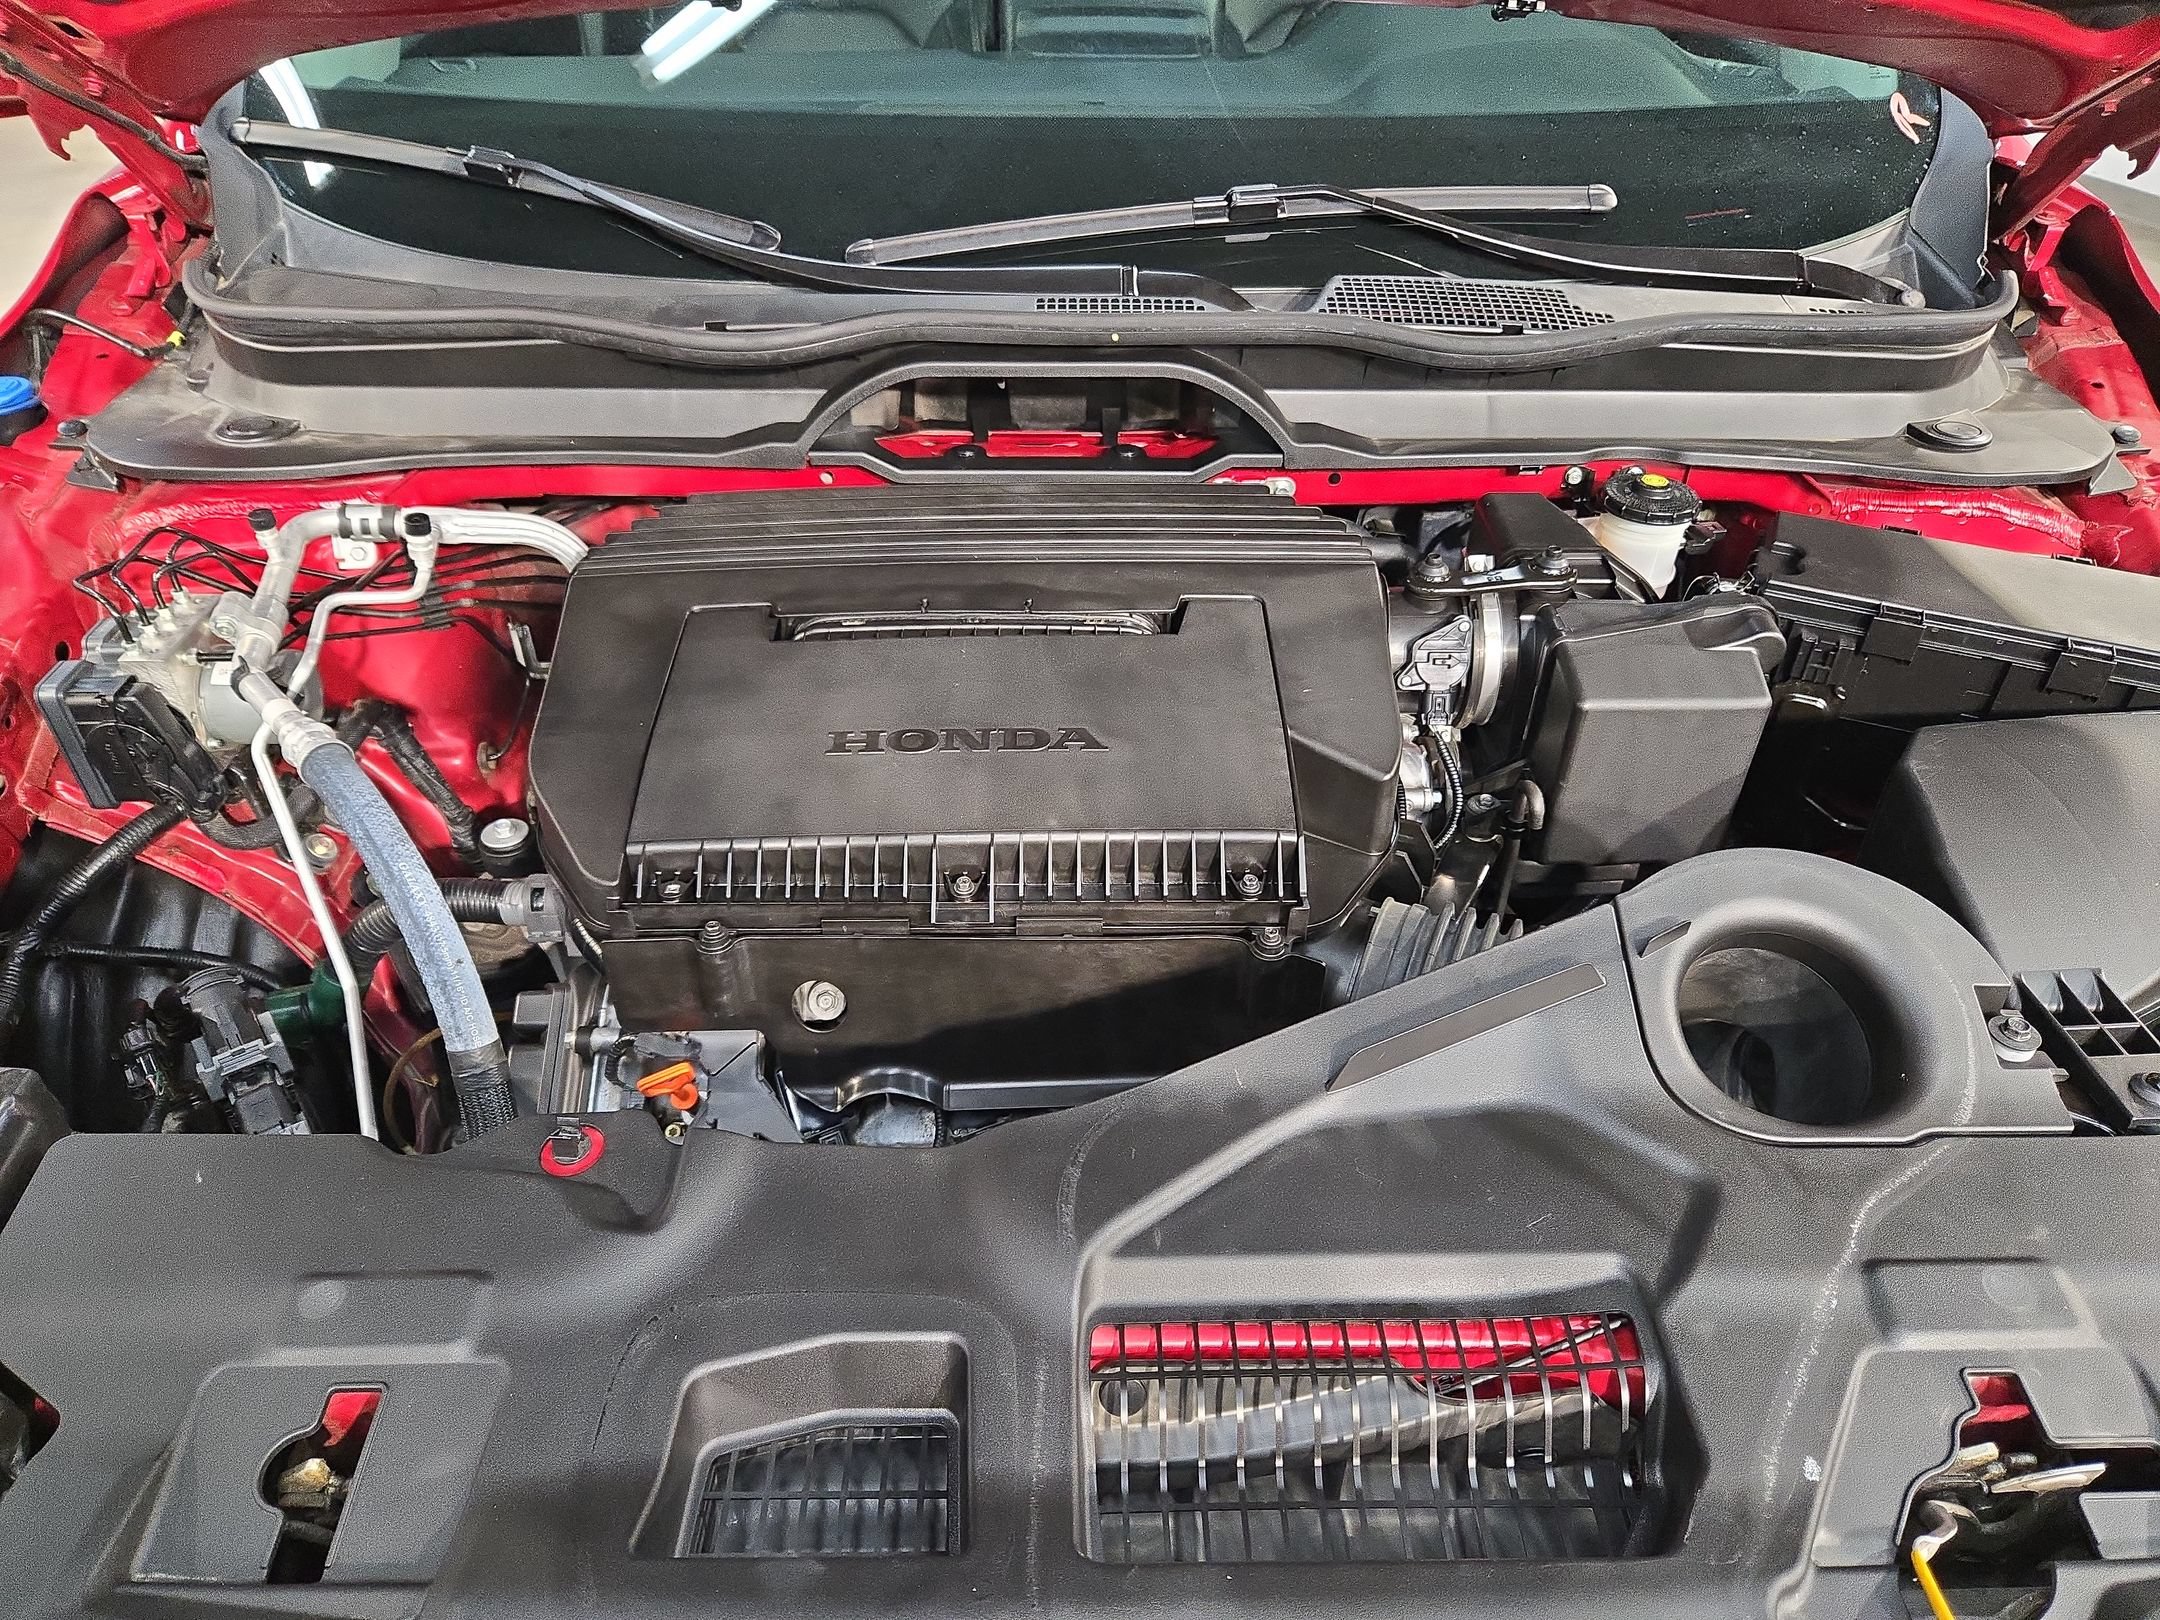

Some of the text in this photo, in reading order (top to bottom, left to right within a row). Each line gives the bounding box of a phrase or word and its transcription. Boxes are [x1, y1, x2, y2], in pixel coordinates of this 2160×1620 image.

[824, 727, 1109, 756] HONDA
[463, 1007, 475, 1022] A/C
[468, 1022, 482, 1049] HOSE
